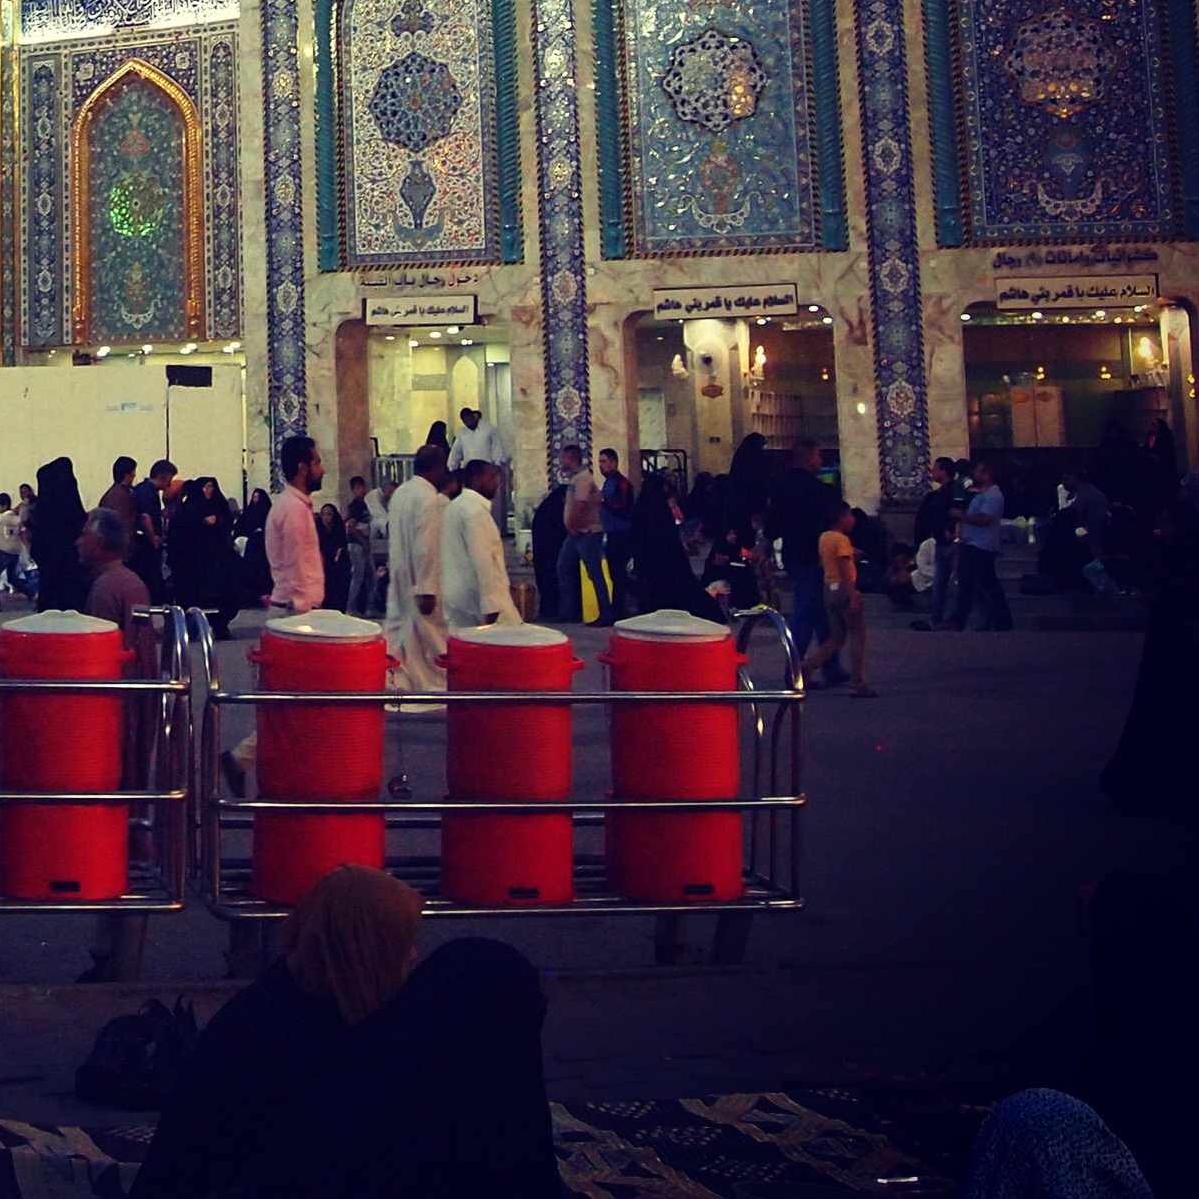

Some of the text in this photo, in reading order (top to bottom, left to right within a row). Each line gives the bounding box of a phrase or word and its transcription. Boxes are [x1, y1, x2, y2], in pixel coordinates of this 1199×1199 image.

[999, 285, 1155, 305] السلام عليك يا قمر بني هاشم
[657, 294, 793, 314] السلام عليك يا قمر بني هاشم
[371, 307, 389, 317] هاشم
[426, 306, 446, 317] عليك
[447, 305, 469, 316] السلام
